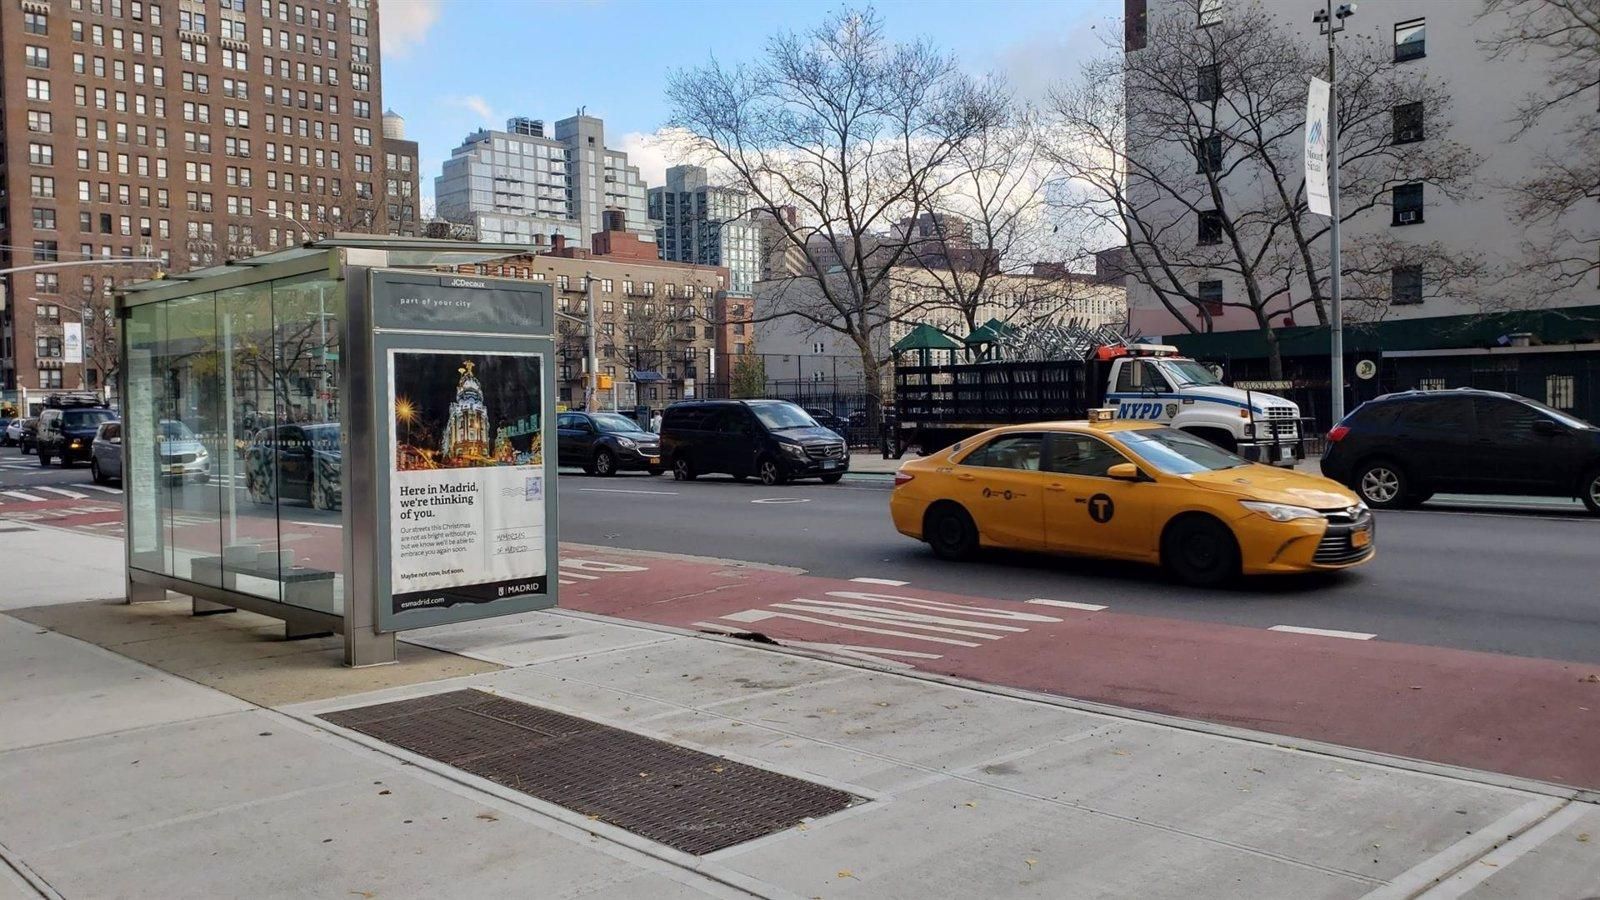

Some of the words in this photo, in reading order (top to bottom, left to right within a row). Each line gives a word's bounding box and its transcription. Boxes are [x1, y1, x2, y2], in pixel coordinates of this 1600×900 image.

[451, 279, 486, 288] JCDecaux
[400, 297, 418, 305] part
[456, 299, 471, 308] city
[1118, 403, 1163, 420] NYPD
[400, 486, 426, 496] Here
[427, 484, 438, 495] in
[439, 482, 479, 494] Madrid,
[400, 498, 428, 508] we're
[430, 494, 474, 506] thinking
[400, 509, 412, 519] of
[413, 509, 436, 521] you.
[401, 572, 418, 580] Maybe
[508, 583, 539, 594] MADRID
[401, 597, 445, 608] esmadrid.com
